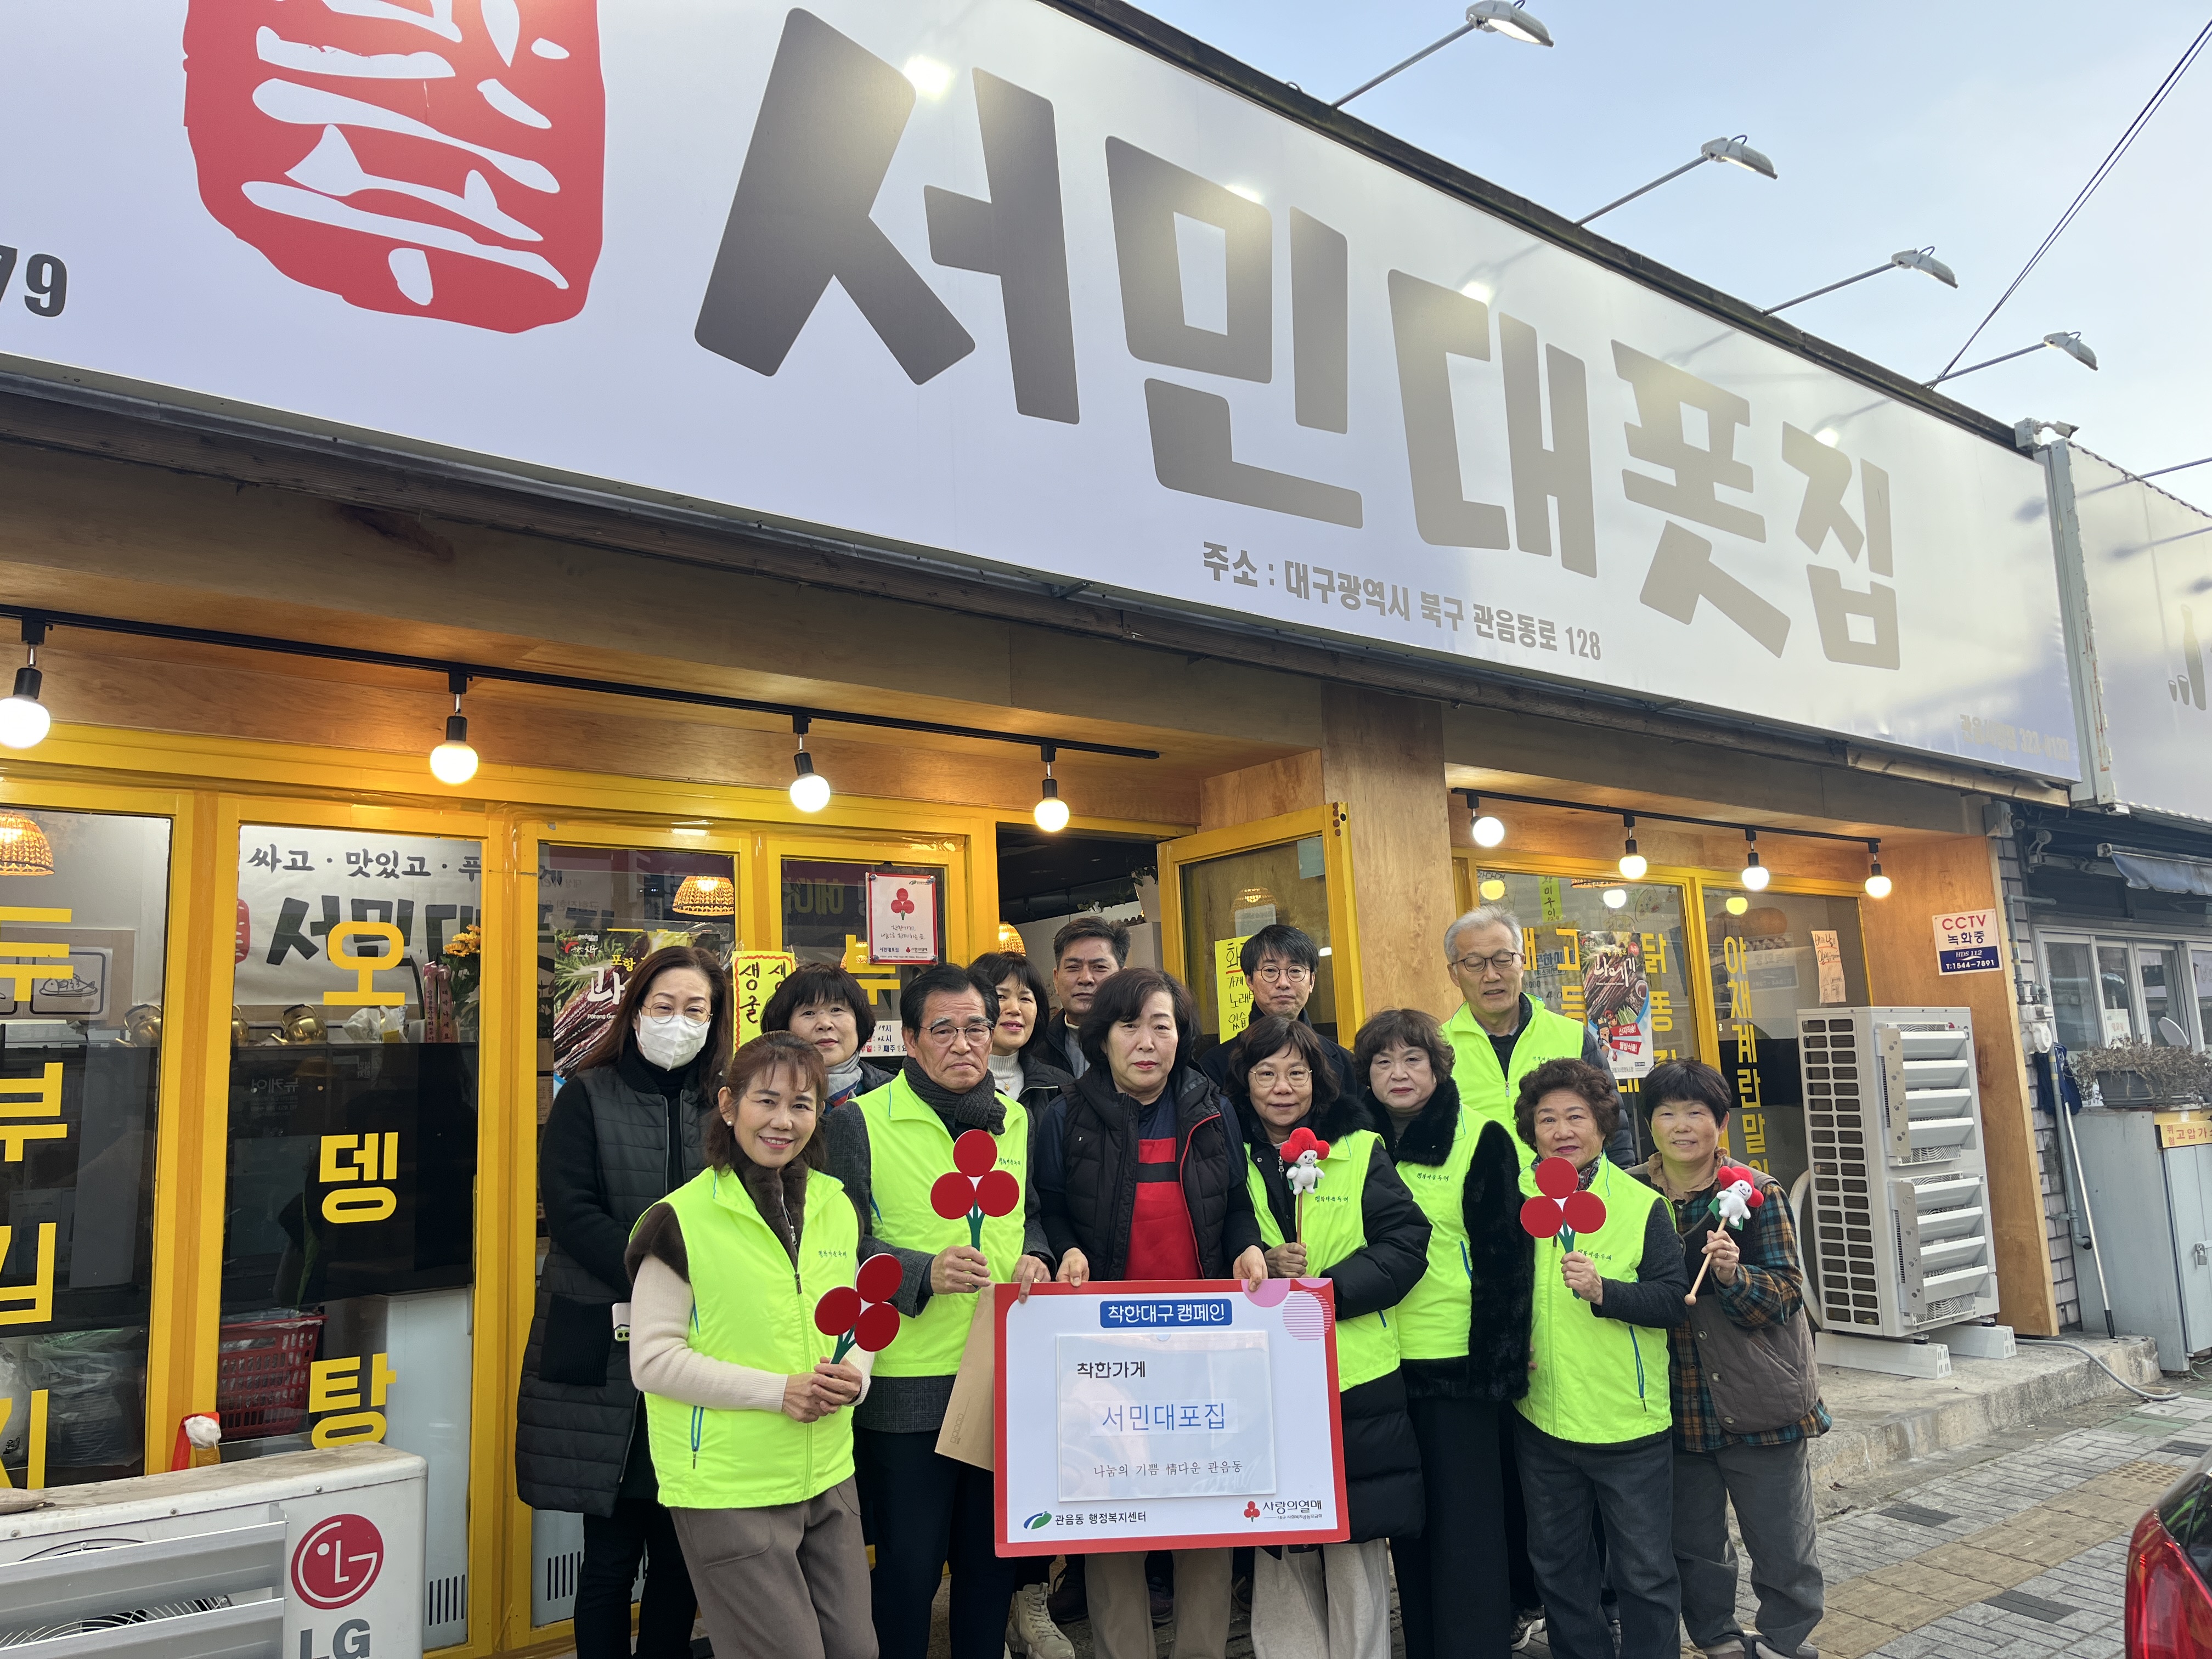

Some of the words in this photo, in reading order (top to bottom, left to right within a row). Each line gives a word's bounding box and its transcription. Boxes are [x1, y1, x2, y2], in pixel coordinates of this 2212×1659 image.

[695, 7, 1900, 670] 서민대폿집
[1203, 541, 1258, 588] 주소
[1284, 560, 1410, 622] 대구광역시
[1420, 591, 1465, 631] 북구
[1473, 603, 1558, 652] 관음동로
[1565, 627, 1601, 661] 128
[247, 843, 315, 873] 싸고
[346, 848, 432, 879] 맛있고
[1942, 915, 1986, 930] CCTV
[1948, 931, 1984, 945] 녹화중
[611, 955, 636, 972] 포항
[1228, 975, 1244, 989] 가게
[2167, 1125, 2175, 1146] 위험
[1108, 1305, 1174, 1323] 착한대구
[1177, 1303, 1224, 1322] 캠페인
[1077, 1361, 1146, 1378] 착한가게
[1102, 1403, 1224, 1431] 서민대포집
[1094, 1464, 1128, 1477] 나눔의
[1136, 1463, 1159, 1476] 기쁨
[1166, 1462, 1201, 1475] 情다운
[1207, 1460, 1243, 1474] 관음동
[1263, 1500, 1322, 1514] 사랑의열매
[1055, 1514, 1084, 1526] 관음동
[1089, 1511, 1146, 1524] 행정복지센터
[300, 1619, 370, 1659] LG
